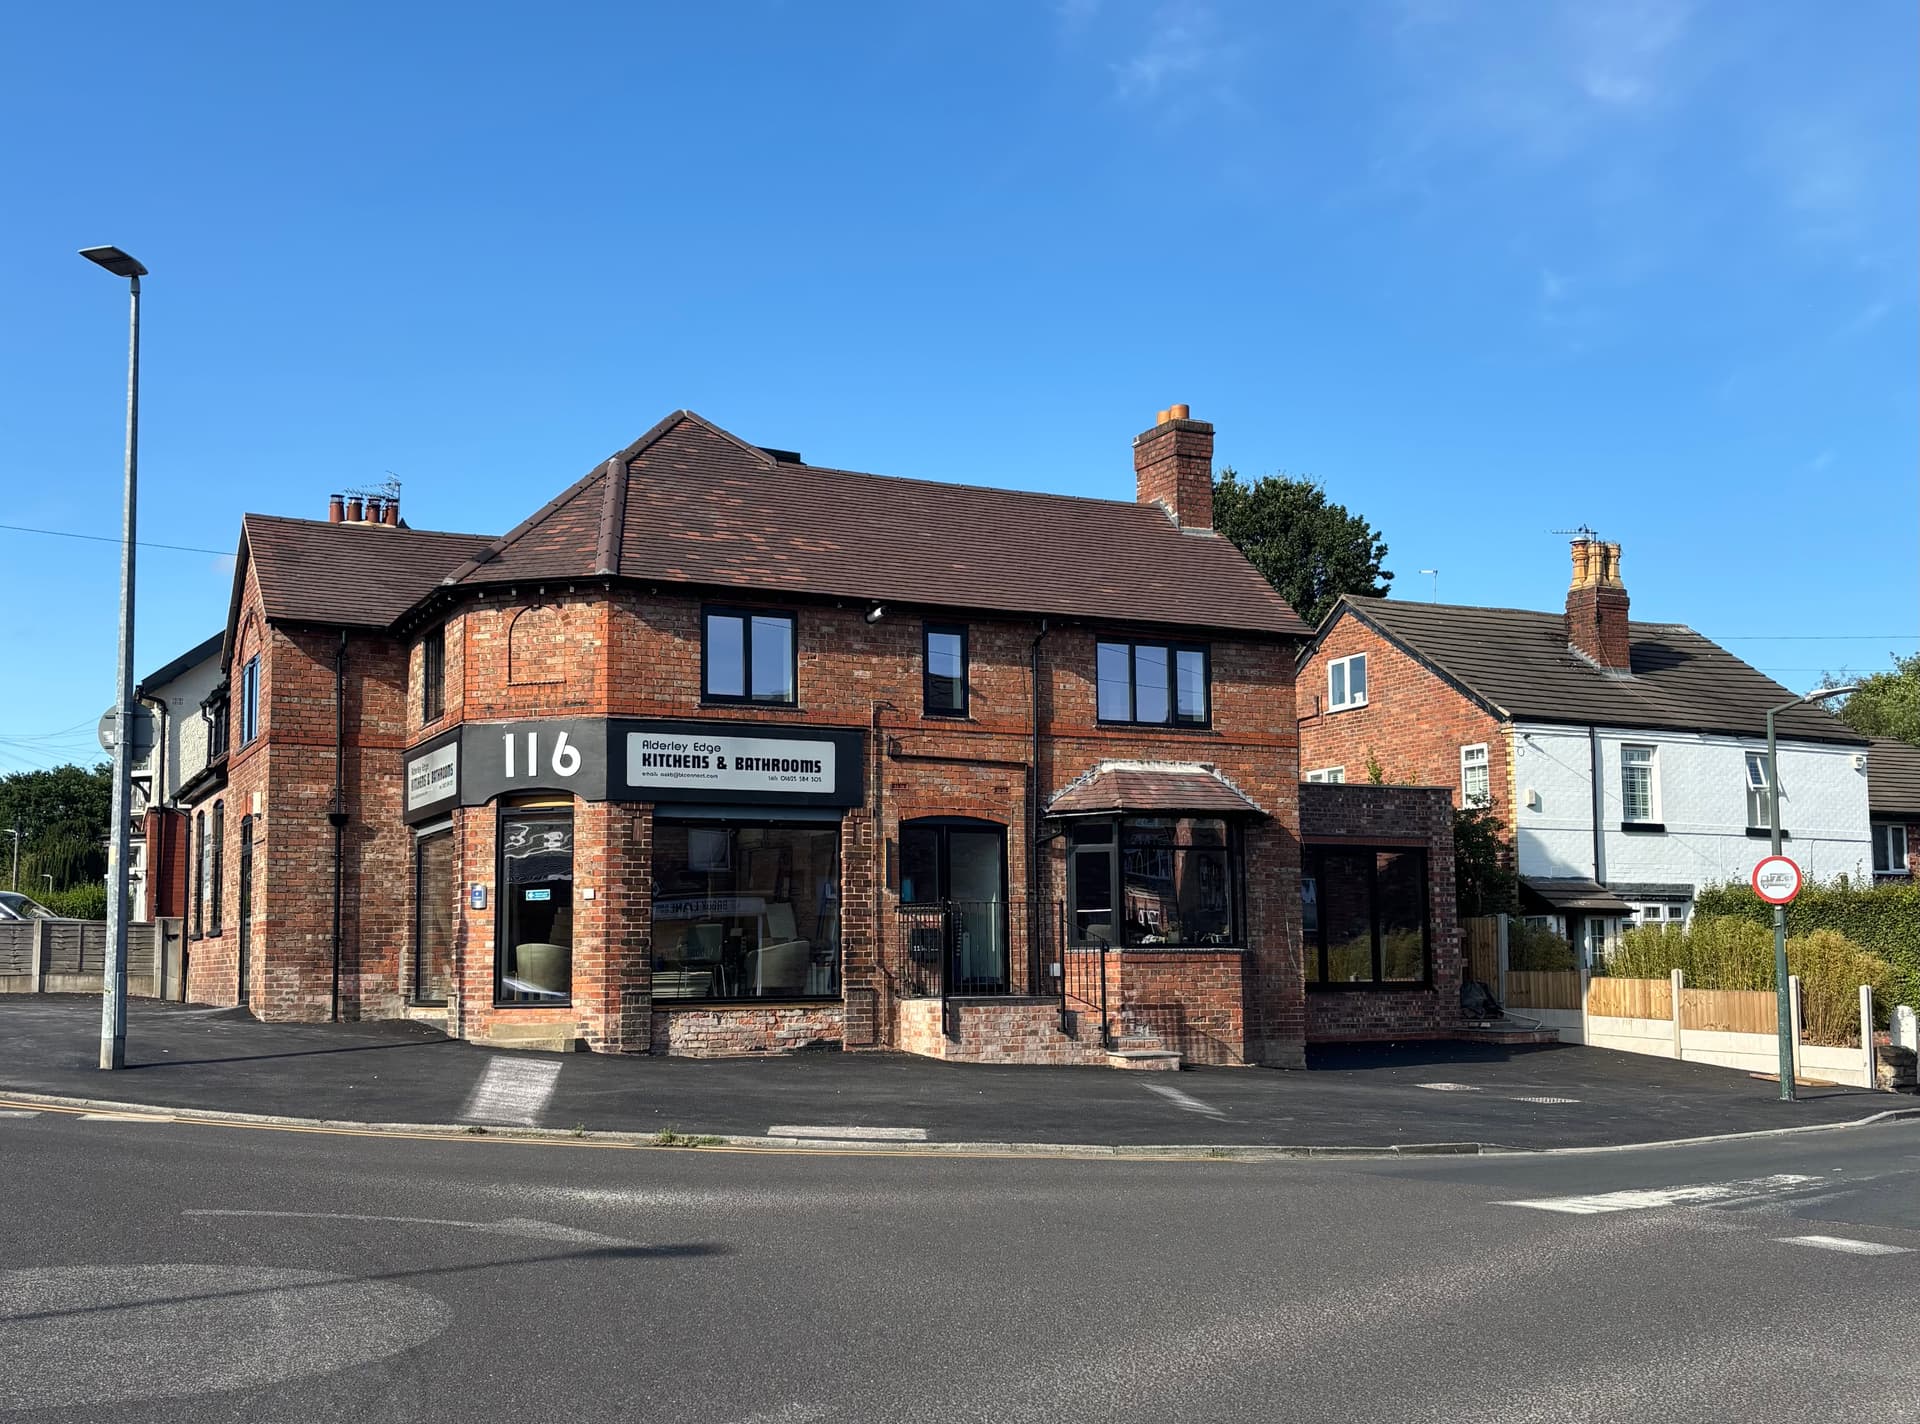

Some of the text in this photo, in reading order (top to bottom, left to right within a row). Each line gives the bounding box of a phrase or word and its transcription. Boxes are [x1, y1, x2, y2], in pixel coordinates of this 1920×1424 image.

[506, 731, 581, 777] 116
[642, 740, 721, 754] Alderley Edge
[642, 753, 821, 773] KITCHENS & BATHROOMS
